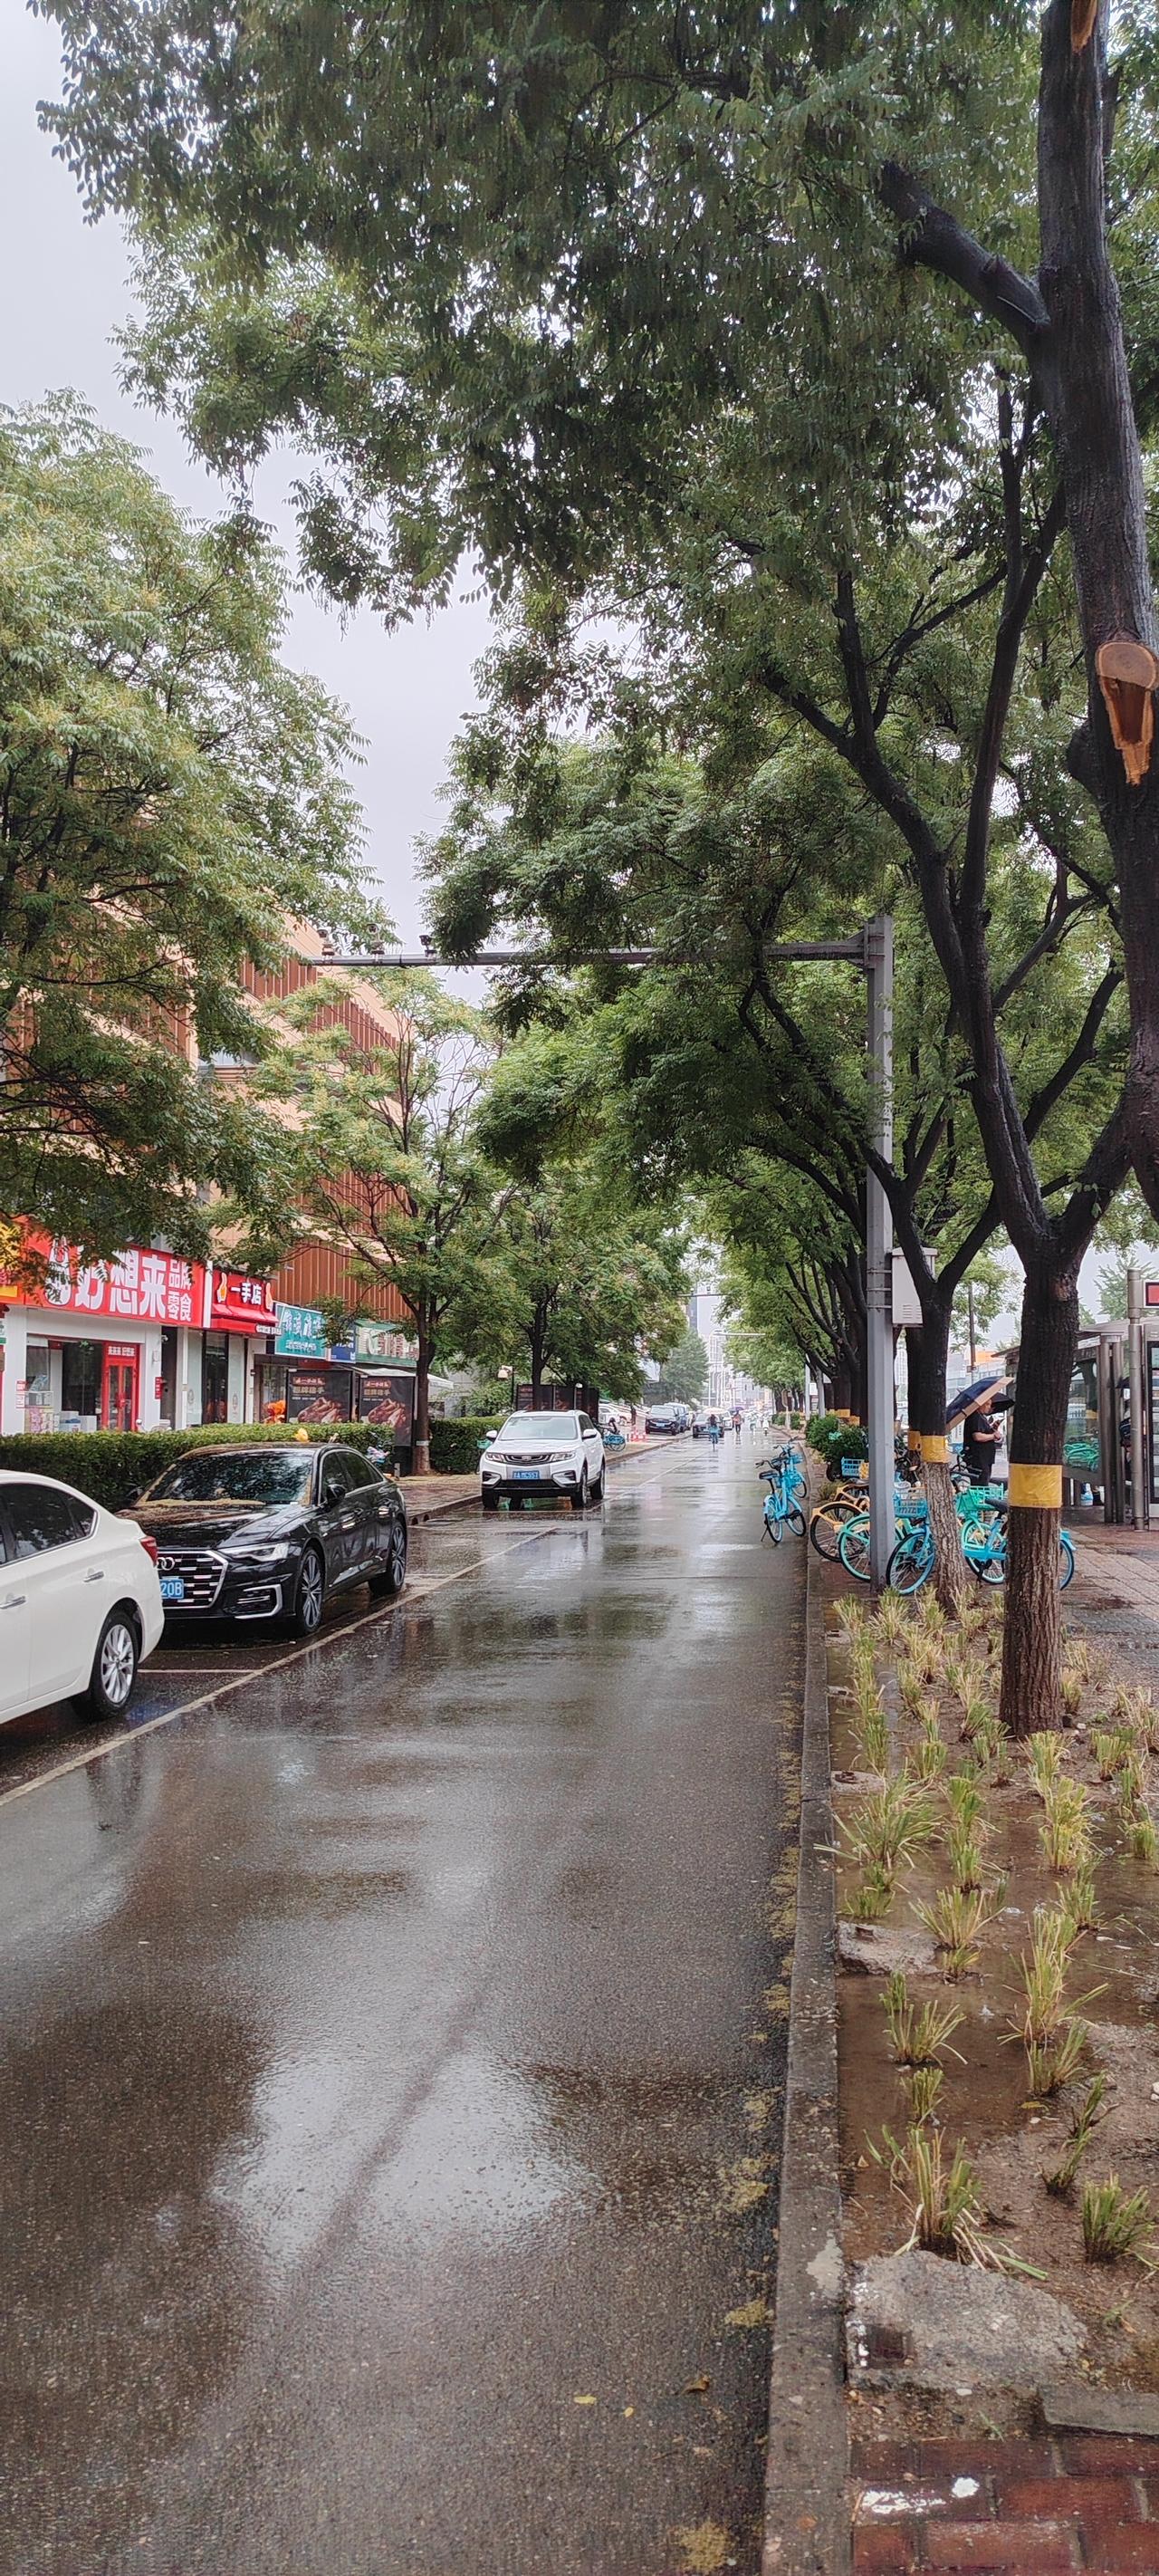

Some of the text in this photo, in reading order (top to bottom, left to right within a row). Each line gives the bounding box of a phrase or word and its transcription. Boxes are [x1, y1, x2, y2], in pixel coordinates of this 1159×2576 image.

[75, 1245, 166, 1319] 好想来
[230, 1282, 262, 1305] 一手店
[168, 1291, 192, 1322] 零食
